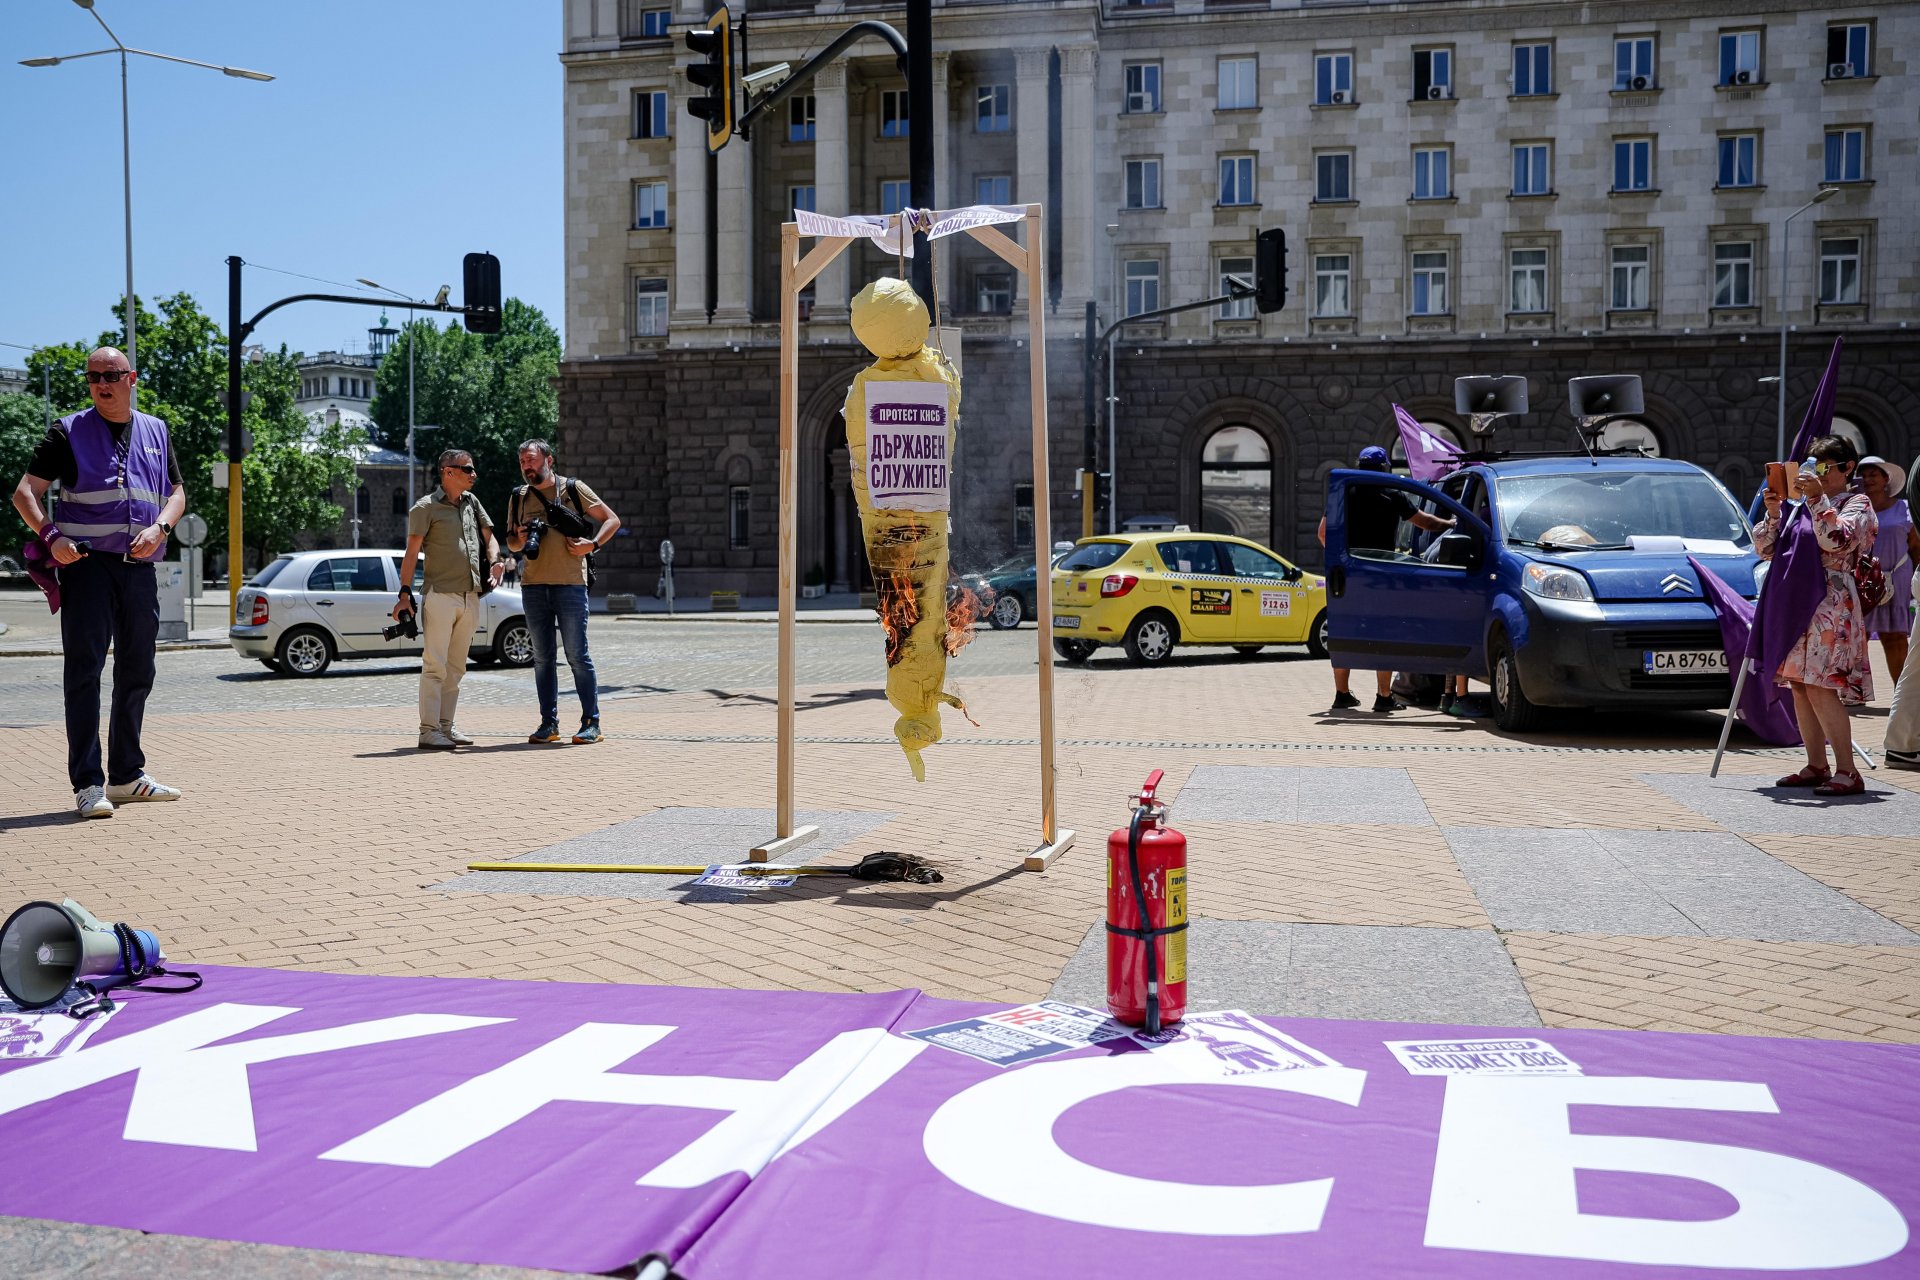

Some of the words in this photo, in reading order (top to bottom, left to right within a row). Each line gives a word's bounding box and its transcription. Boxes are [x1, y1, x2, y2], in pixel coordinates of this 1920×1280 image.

[933, 216, 986, 236] БЮДЖЕТ
[880, 408, 918, 421] ПРОТЕСТ
[920, 409, 940, 422] КНСБ
[871, 434, 945, 462] ДЪРЖАВЕН
[871, 464, 946, 489] СЛУЖИТЕЛ
[1655, 653, 1675, 669] CA
[1679, 652, 1717, 668] 8796
[719, 868, 740, 877] КНС
[1417, 1043, 1461, 1053] КНСБ
[1463, 1041, 1532, 1051] ПРОТЕСТ
[1408, 1053, 1517, 1070] БЮДЖЕТ
[1512, 1051, 1569, 1067] 2026
[0, 1002, 1909, 1269] КНСБ
